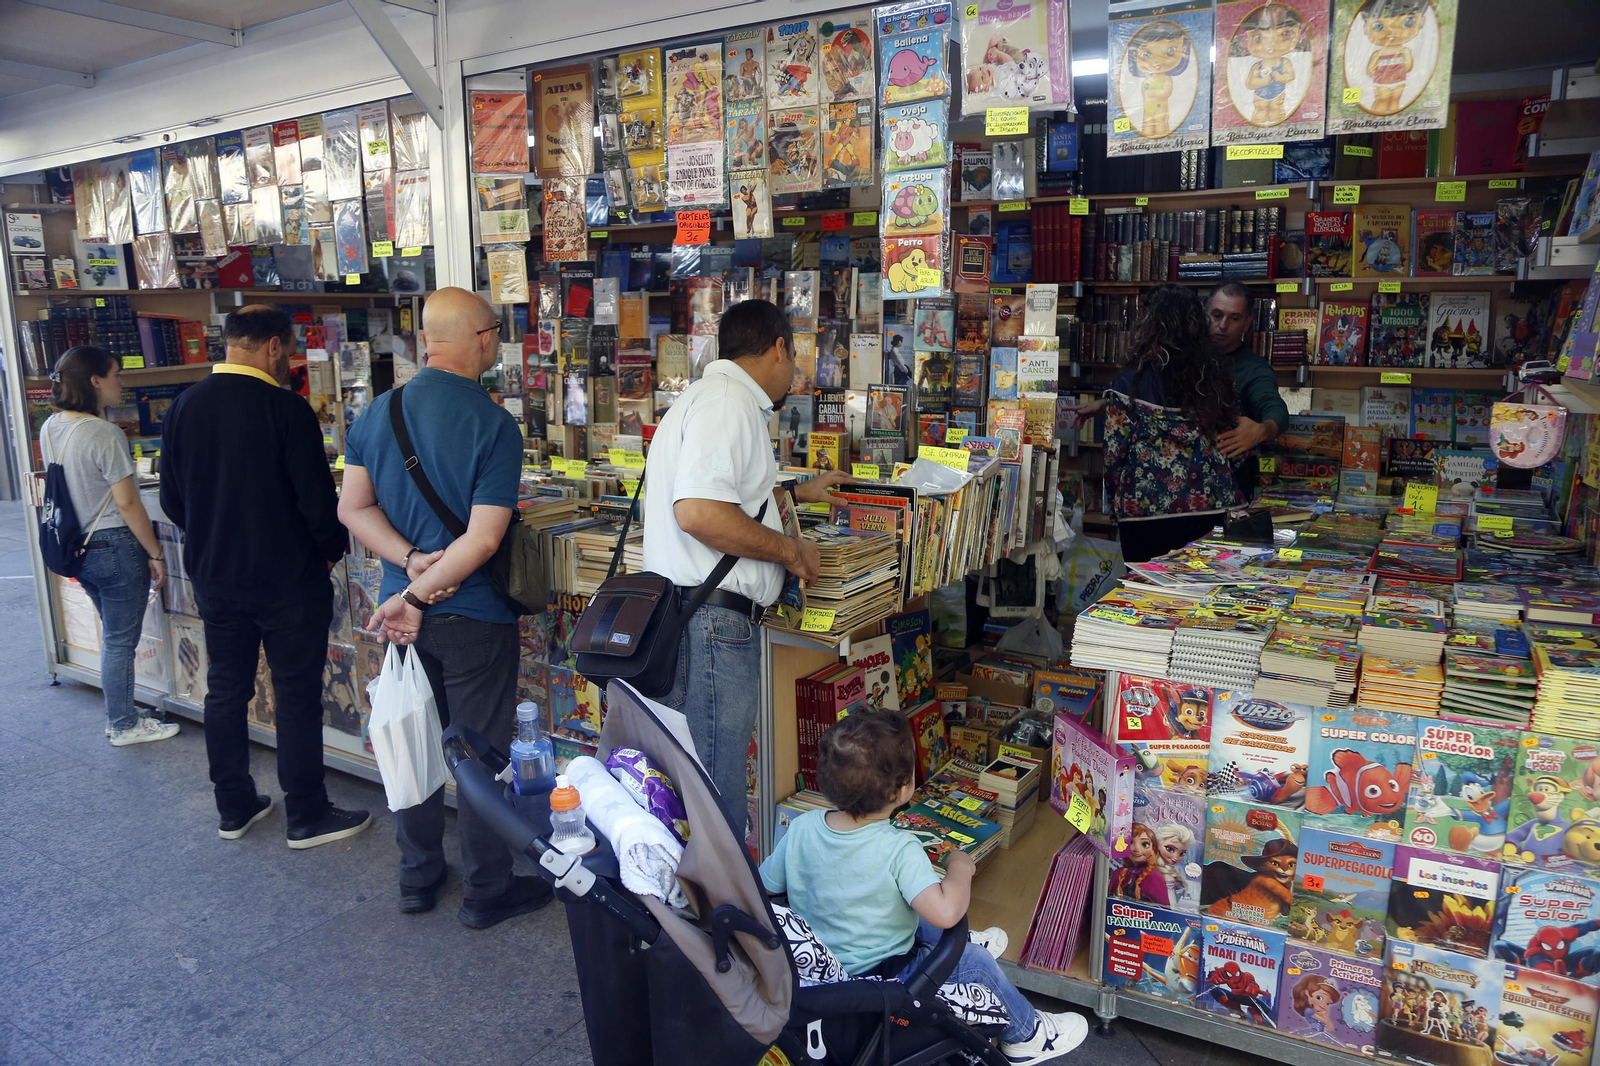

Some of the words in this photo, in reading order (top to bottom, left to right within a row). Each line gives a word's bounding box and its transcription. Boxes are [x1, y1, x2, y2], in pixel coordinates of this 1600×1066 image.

[930, 6, 947, 14] baño
[779, 21, 809, 37] THOR
[726, 30, 762, 42] TARZAN
[895, 36, 928, 48] Ballena
[545, 82, 583, 95] ATLAS
[1345, 91, 1358, 100] 2€
[728, 107, 764, 118] TARZAN
[900, 106, 927, 118] Oveja
[780, 113, 804, 124] THOR
[1342, 119, 1392, 131] Boutique
[1406, 116, 1439, 126] Elena
[1118, 120, 1129, 130] 2€
[1226, 130, 1272, 142] Boutique
[1286, 127, 1319, 138] Laura
[1118, 142, 1162, 153] Boutique
[1230, 146, 1282, 156] RECORTABLES
[1346, 148, 1372, 156] QUIJOTES
[729, 170, 764, 180] TARZAN
[896, 172, 932, 183] Tortuga
[1491, 180, 1514, 188] CONAN
[678, 213, 710, 221] CARTELES
[1314, 215, 1342, 223] GRANDES
[685, 232, 699, 242] 3€
[898, 238, 923, 247] Perro
[548, 251, 579, 261] ESOPO
[282, 279, 296, 291] tai
[298, 279, 314, 291] chi
[1389, 308, 1414, 316] 1000
[1382, 317, 1419, 325] FUTBOLISTAS
[1028, 360, 1049, 368] ANTI
[819, 415, 827, 424] DE
[827, 415, 844, 424] TROYA
[925, 448, 936, 457] SE
[939, 449, 968, 460] COMPRAN
[1283, 463, 1336, 478] BICHOS
[1448, 462, 1483, 470] FAMILIAS
[863, 514, 888, 524] JULIO
[860, 523, 887, 532] VERNE
[892, 616, 924, 634] SIMPSON
[558, 673, 588, 693] FLASH
[1121, 689, 1160, 708] PAW
[1129, 706, 1151, 714] PATROL
[1227, 700, 1298, 724] TURBO
[1129, 718, 1141, 728] 3€
[1240, 731, 1289, 744] CARACOL
[1321, 727, 1368, 742] SUPER
[1370, 732, 1416, 746] COLOR
[1426, 726, 1472, 745] SÚPER
[1223, 737, 1240, 745] DE
[1240, 739, 1296, 754] CARRERAS
[1422, 738, 1492, 759] PEGACOLOR
[1528, 750, 1566, 763] Tigger
[1532, 762, 1560, 772] Pooh
[1162, 796, 1196, 810] SUPER
[1072, 812, 1084, 828] 5€
[1152, 805, 1200, 824] JUEGOS
[1252, 820, 1274, 828] BOTAS
[1413, 832, 1434, 844] 40
[1439, 865, 1468, 876] Descubre
[1306, 876, 1320, 889] 3€
[1419, 869, 1438, 881] Los
[1441, 873, 1488, 891] insectos
[1519, 894, 1592, 910] Super
[1112, 904, 1154, 920] Súper
[1523, 909, 1587, 922] color
[1107, 916, 1182, 934] PANORAMA
[1113, 939, 1140, 950] Decorados
[1110, 956, 1141, 967] Recortables
[1207, 945, 1237, 962] MAXI
[1240, 951, 1276, 970] COLOR
[1329, 960, 1374, 976] Primeras
[1502, 992, 1537, 1008] EQUIPO
[1548, 1003, 1592, 1023] RESCATE
